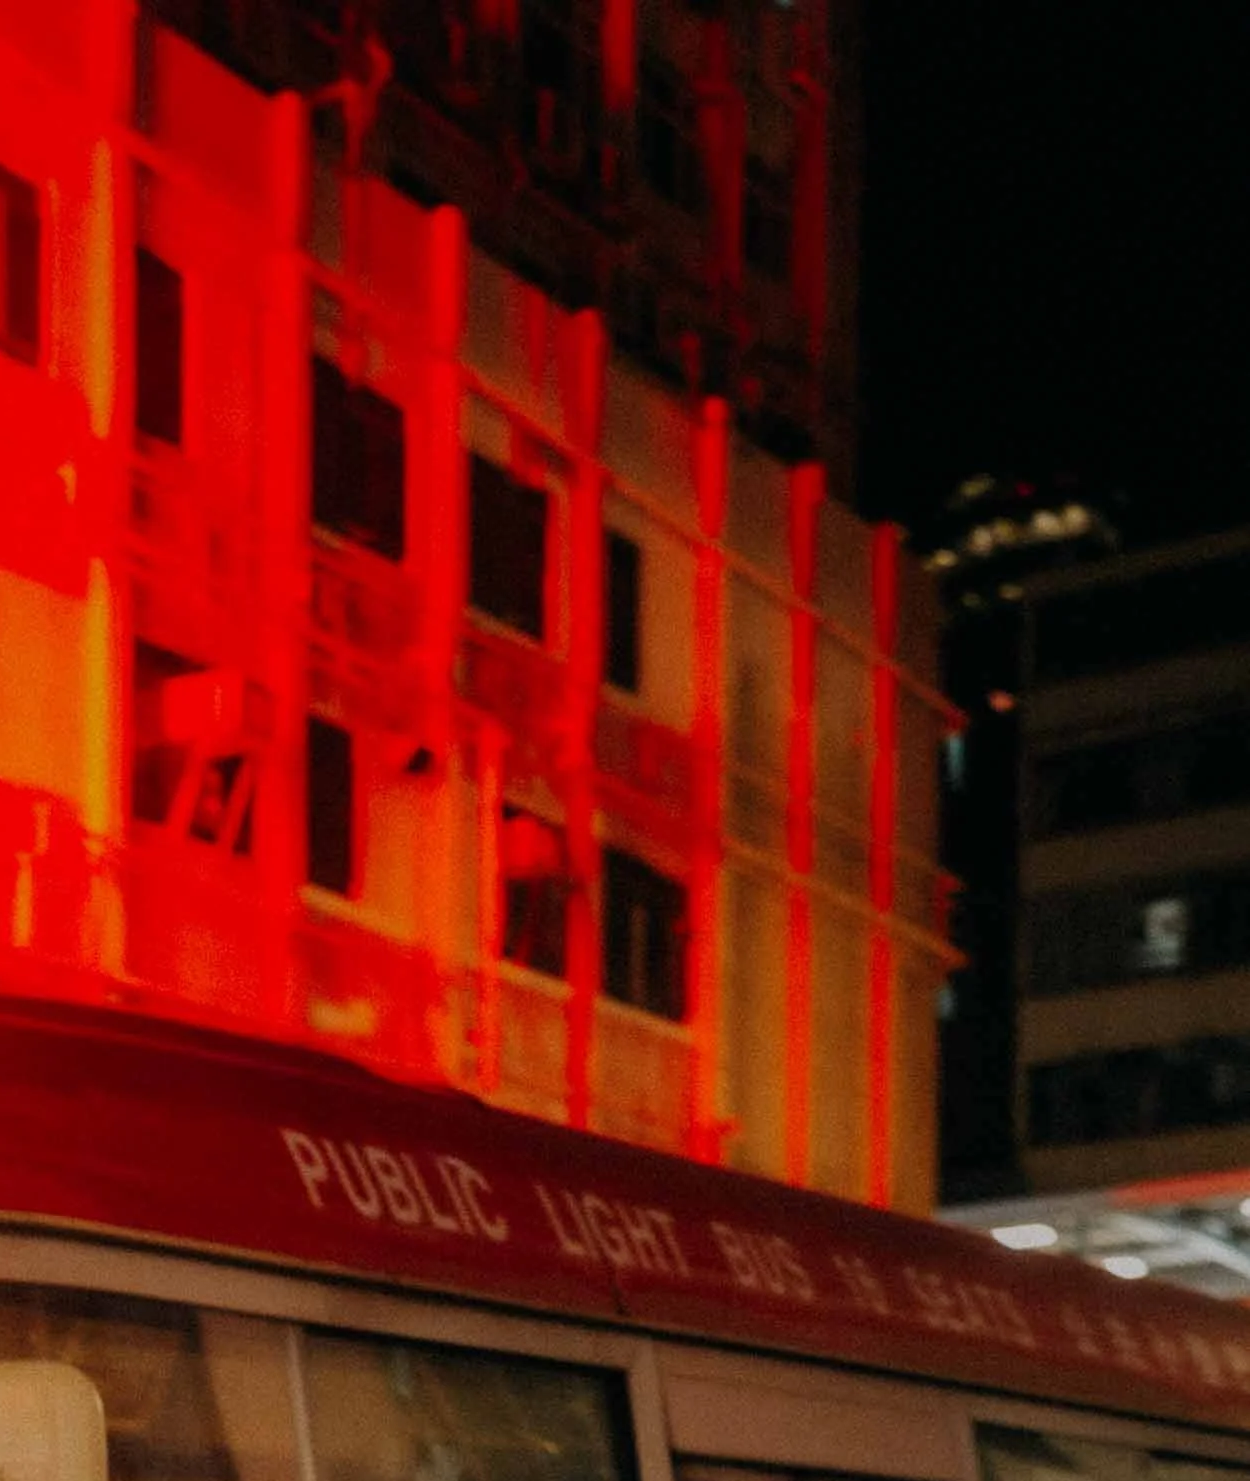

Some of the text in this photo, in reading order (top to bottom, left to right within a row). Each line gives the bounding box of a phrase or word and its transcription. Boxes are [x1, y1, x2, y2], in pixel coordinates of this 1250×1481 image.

[280, 1126, 509, 1243] PUBLIC
[536, 1182, 691, 1278] LIGHT
[709, 1218, 814, 1301] BUS
